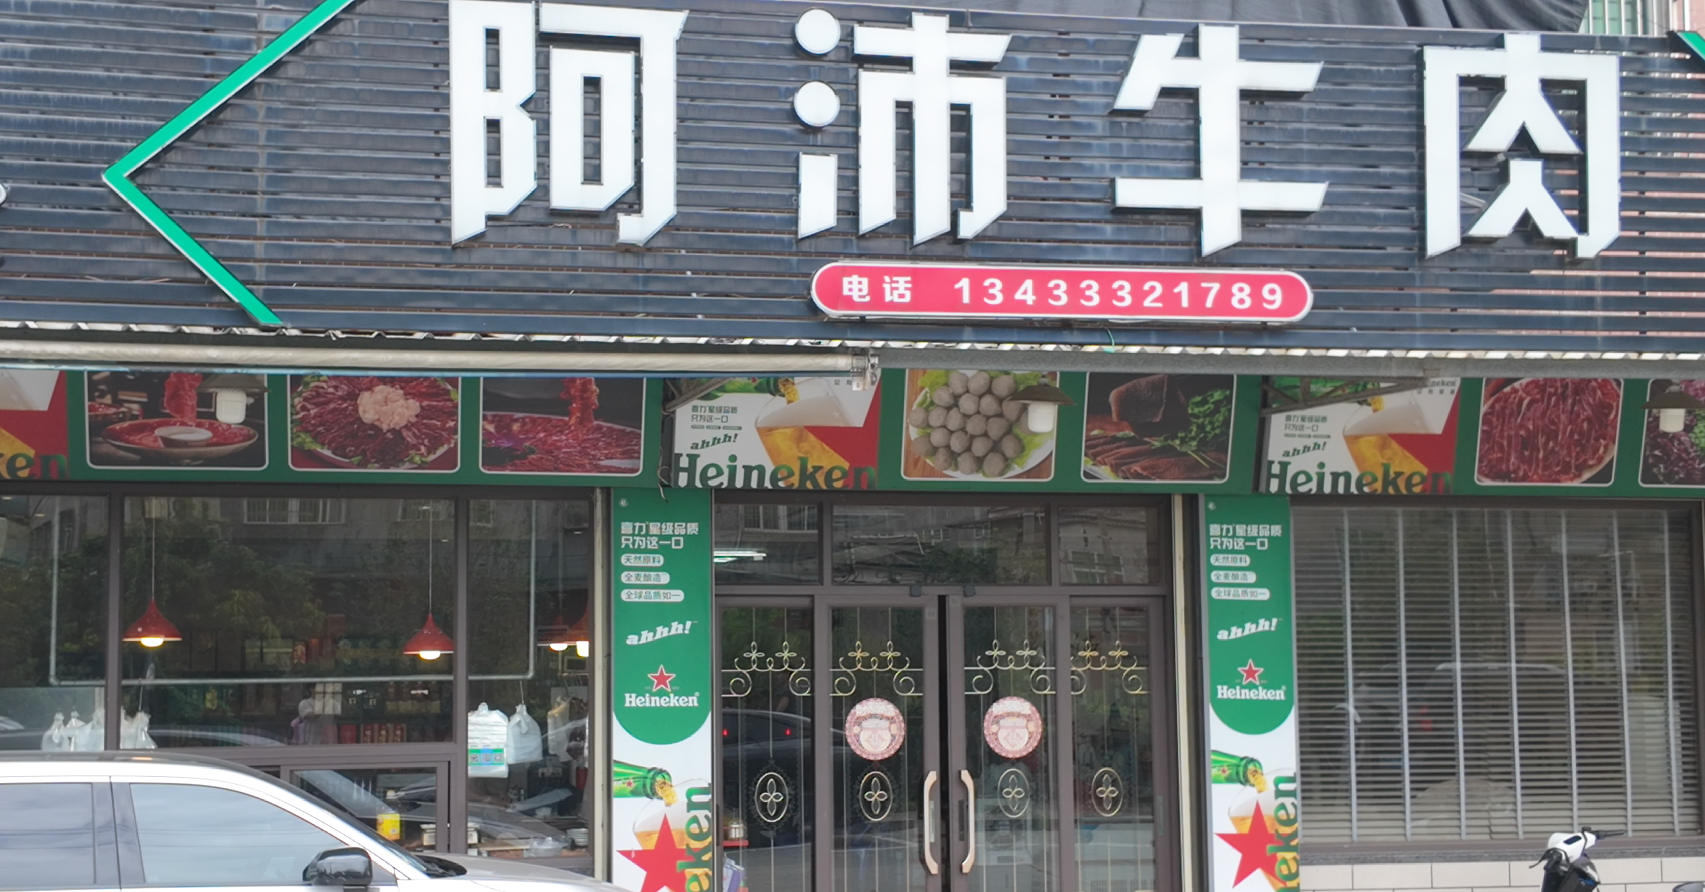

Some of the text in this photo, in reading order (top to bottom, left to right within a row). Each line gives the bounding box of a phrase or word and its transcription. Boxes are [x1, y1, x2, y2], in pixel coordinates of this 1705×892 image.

[842, 274, 1284, 310] 电话 13433321789
[690, 433, 738, 450] ahhh!
[1282, 441, 1328, 458] ahhh!
[674, 453, 876, 490] Heineken
[1267, 460, 1452, 495] Heineken
[621, 536, 684, 549] 只为这一口
[1209, 538, 1268, 550] 只为这一口
[624, 555, 661, 565] 天然原料
[1213, 555, 1248, 565] 天然原料
[624, 573, 662, 583] 全麦酿造
[1213, 572, 1249, 582] 全麦酿造
[625, 590, 681, 600] 全球品质如一
[1214, 588, 1267, 599] 全球品质如一
[626, 620, 692, 646] ahhh!
[1216, 618, 1278, 641] ahhh!
[624, 692, 699, 707] Heineken
[1216, 684, 1286, 700] Heineken
